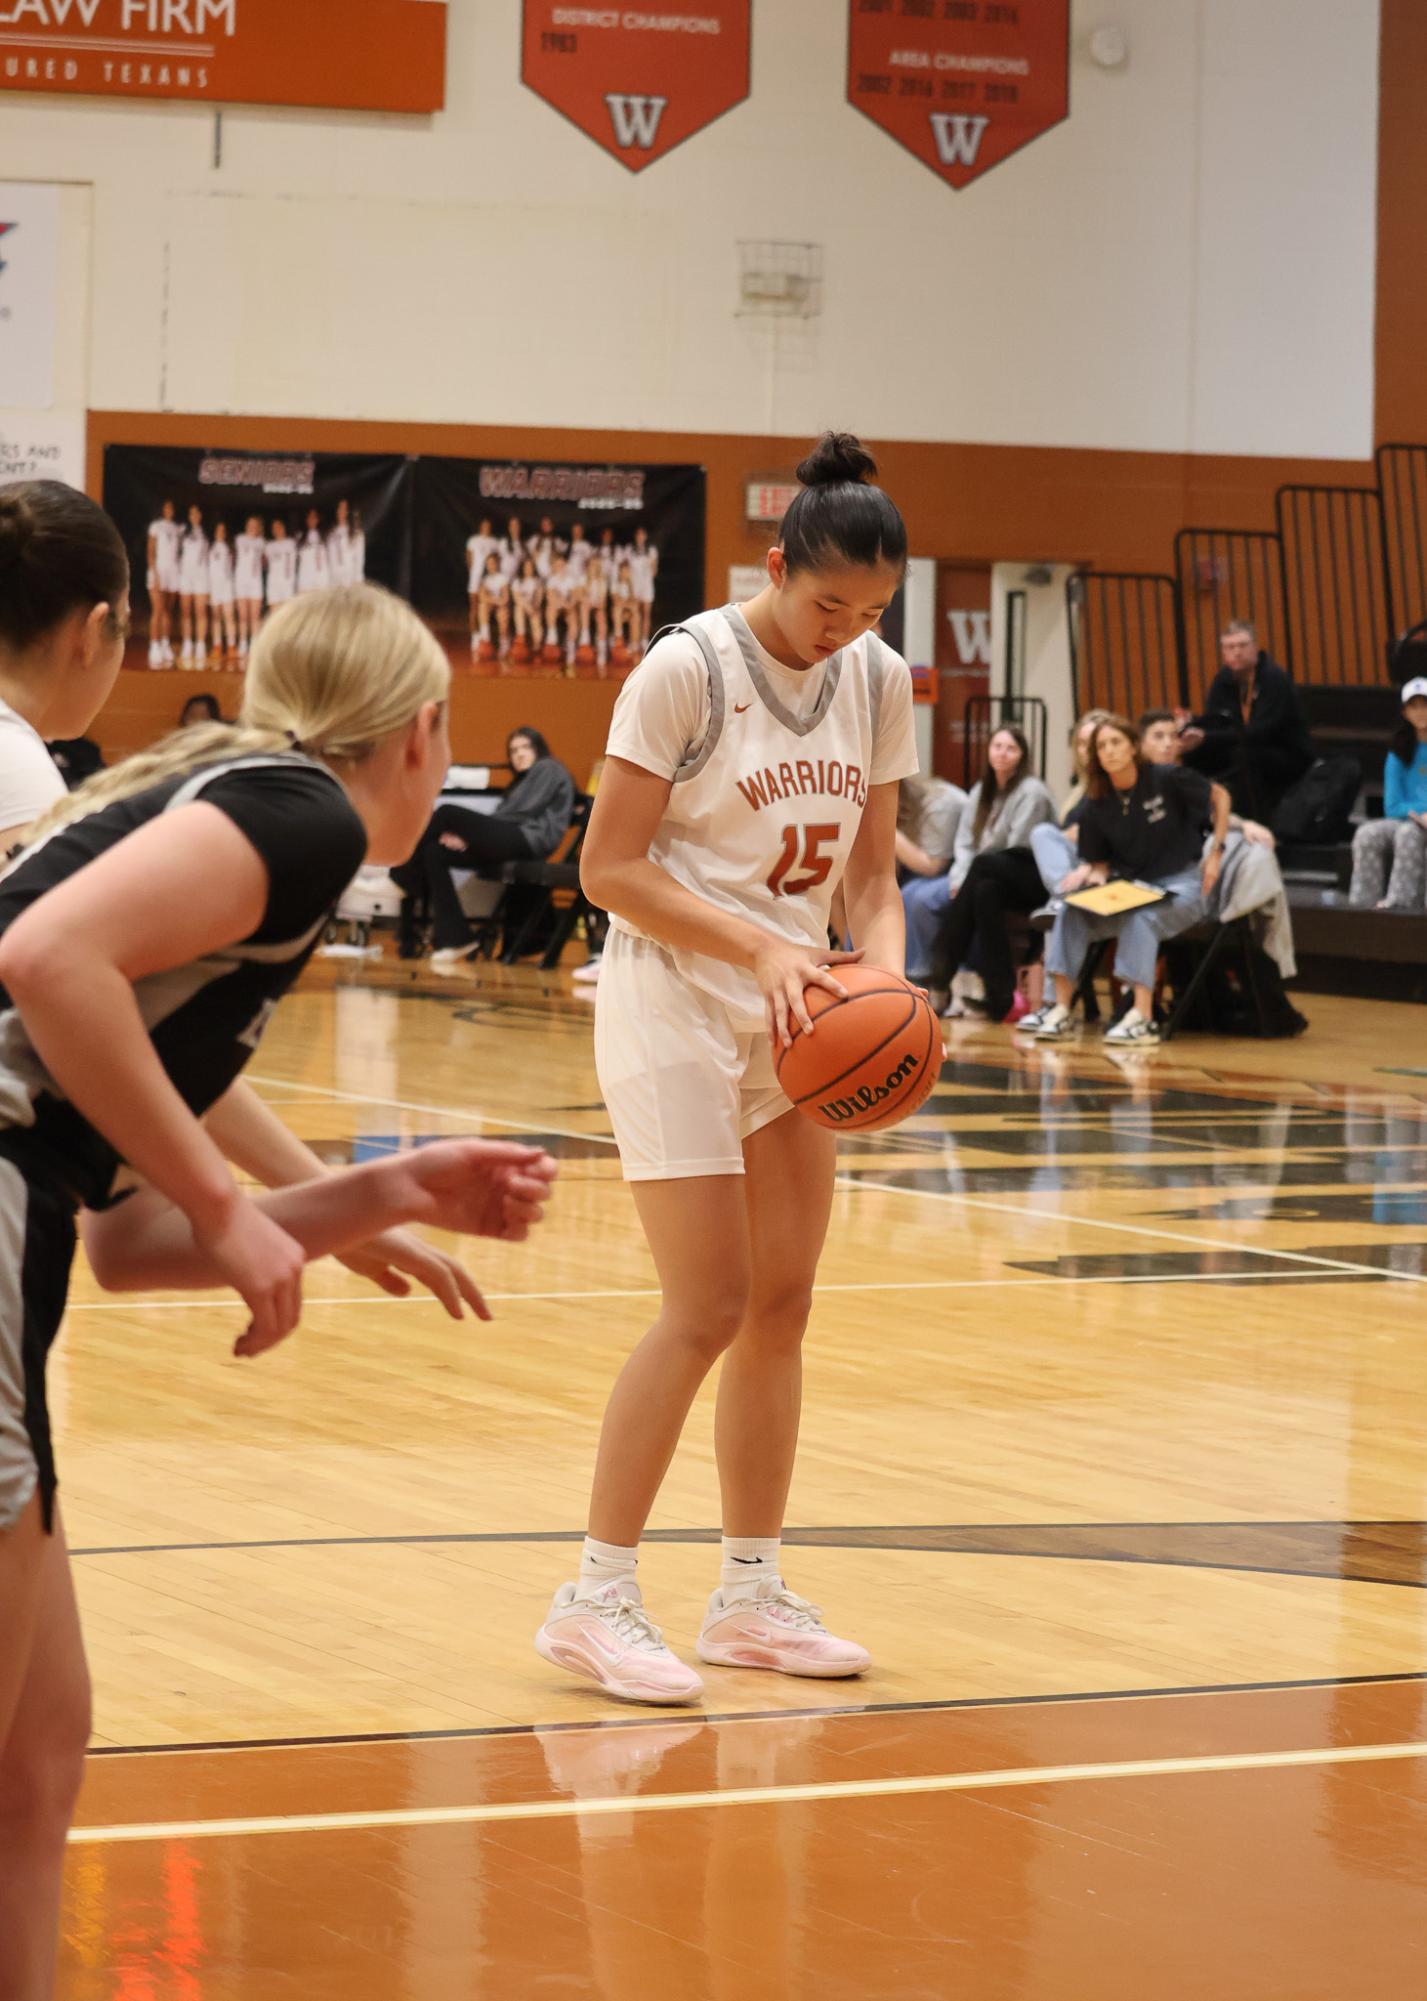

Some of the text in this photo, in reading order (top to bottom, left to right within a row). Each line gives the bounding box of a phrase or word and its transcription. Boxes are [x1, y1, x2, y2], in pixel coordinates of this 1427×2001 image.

[121, 0, 237, 37] FIRM
[552, 8, 721, 34] DISTRICT CHAMPIONS
[103, 60, 208, 88] TEXANS
[889, 51, 1030, 75] AREA CHAMPIONS
[603, 92, 668, 150] W
[929, 112, 990, 166] W
[199, 458, 315, 486] SENIORS
[479, 465, 645, 501] WARRIORS
[946, 610, 991, 664] W
[736, 759, 867, 812] WARRIORS
[766, 822, 842, 900] 15
[818, 1053, 920, 1122] Wilson
